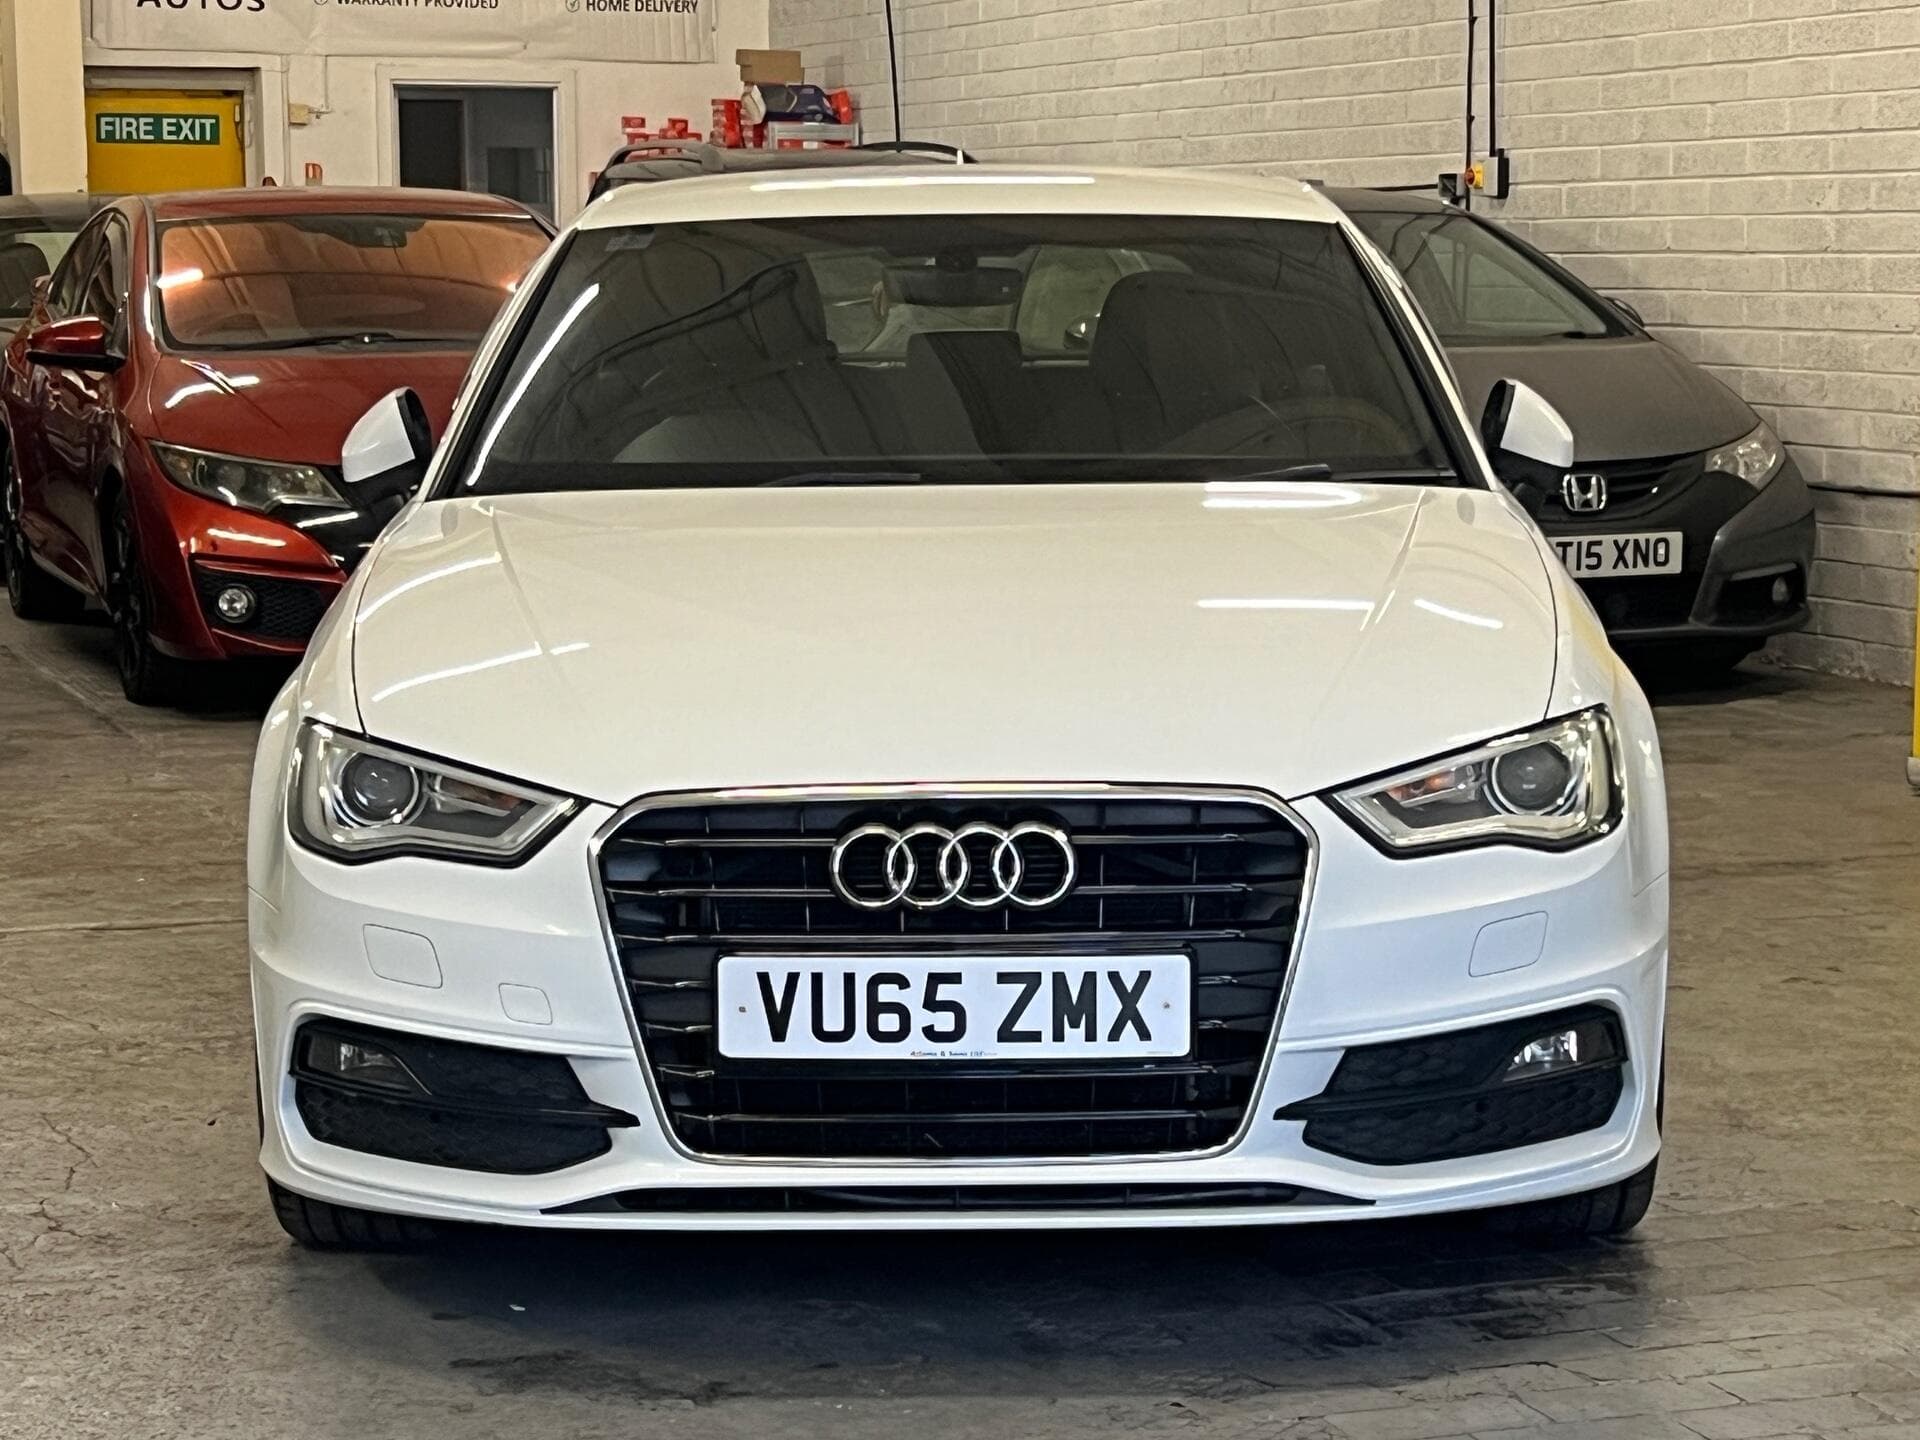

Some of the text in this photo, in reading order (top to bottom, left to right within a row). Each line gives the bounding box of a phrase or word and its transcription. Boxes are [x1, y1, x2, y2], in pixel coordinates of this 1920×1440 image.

[586, 0, 699, 13] HOME DELIVERY
[100, 117, 216, 141] FIRE EXIT
[1612, 537, 1670, 570] XNO
[757, 970, 1152, 1043] VU65 ZMX
